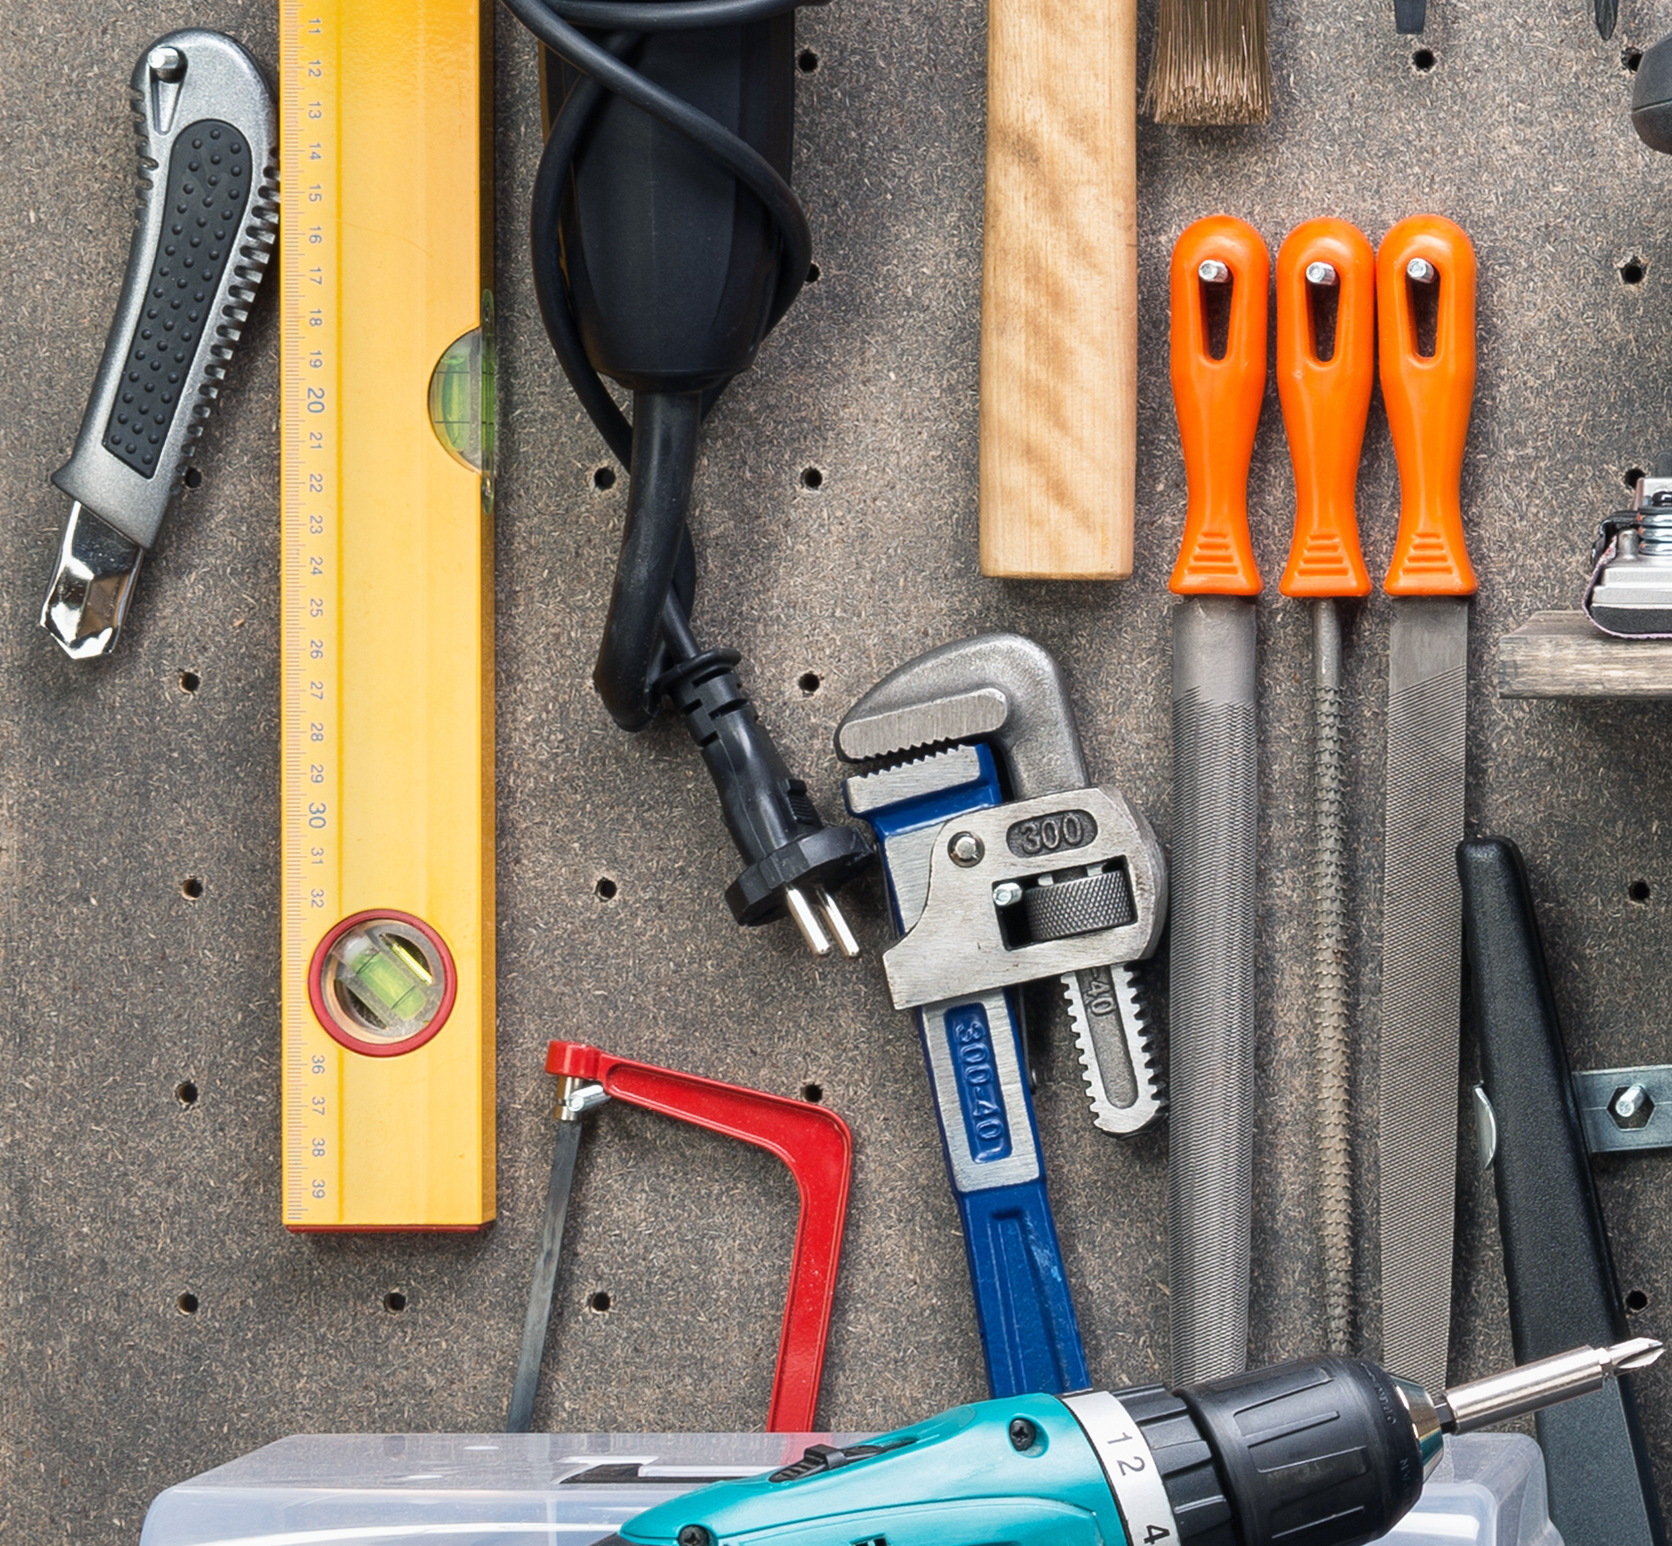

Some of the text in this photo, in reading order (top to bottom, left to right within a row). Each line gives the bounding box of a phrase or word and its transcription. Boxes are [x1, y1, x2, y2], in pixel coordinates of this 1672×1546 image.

[308, 17, 323, 35] 11
[308, 59, 323, 79] 12
[308, 100, 323, 120] 13
[309, 142, 323, 162] 14
[308, 184, 324, 204] 15
[308, 225, 324, 245] 16
[310, 267, 324, 285] 17
[309, 308, 324, 328] 18
[309, 350, 324, 370] 19
[306, 386, 327, 414] 20
[309, 432, 324, 449] 21
[309, 473, 324, 493] 22
[309, 515, 325, 535] 23
[310, 556, 324, 576] 24
[310, 598, 324, 618] 25
[310, 639, 325, 659] 26
[310, 681, 325, 701] 27
[310, 722, 325, 743] 28
[310, 765, 323, 784] 29
[308, 803, 328, 830] 30
[1020, 813, 1083, 854] 300
[310, 848, 325, 864] 31
[310, 889, 326, 909] 32
[311, 1055, 327, 1074] 36
[954, 1021, 1004, 1139] 300-40
[312, 1096, 326, 1116] 37
[311, 1138, 326, 1158] 38
[311, 1180, 327, 1200] 39
[1107, 1432, 1133, 1445] 1
[1117, 1456, 1146, 1476] 2
[1144, 1524, 1171, 1546] 4
